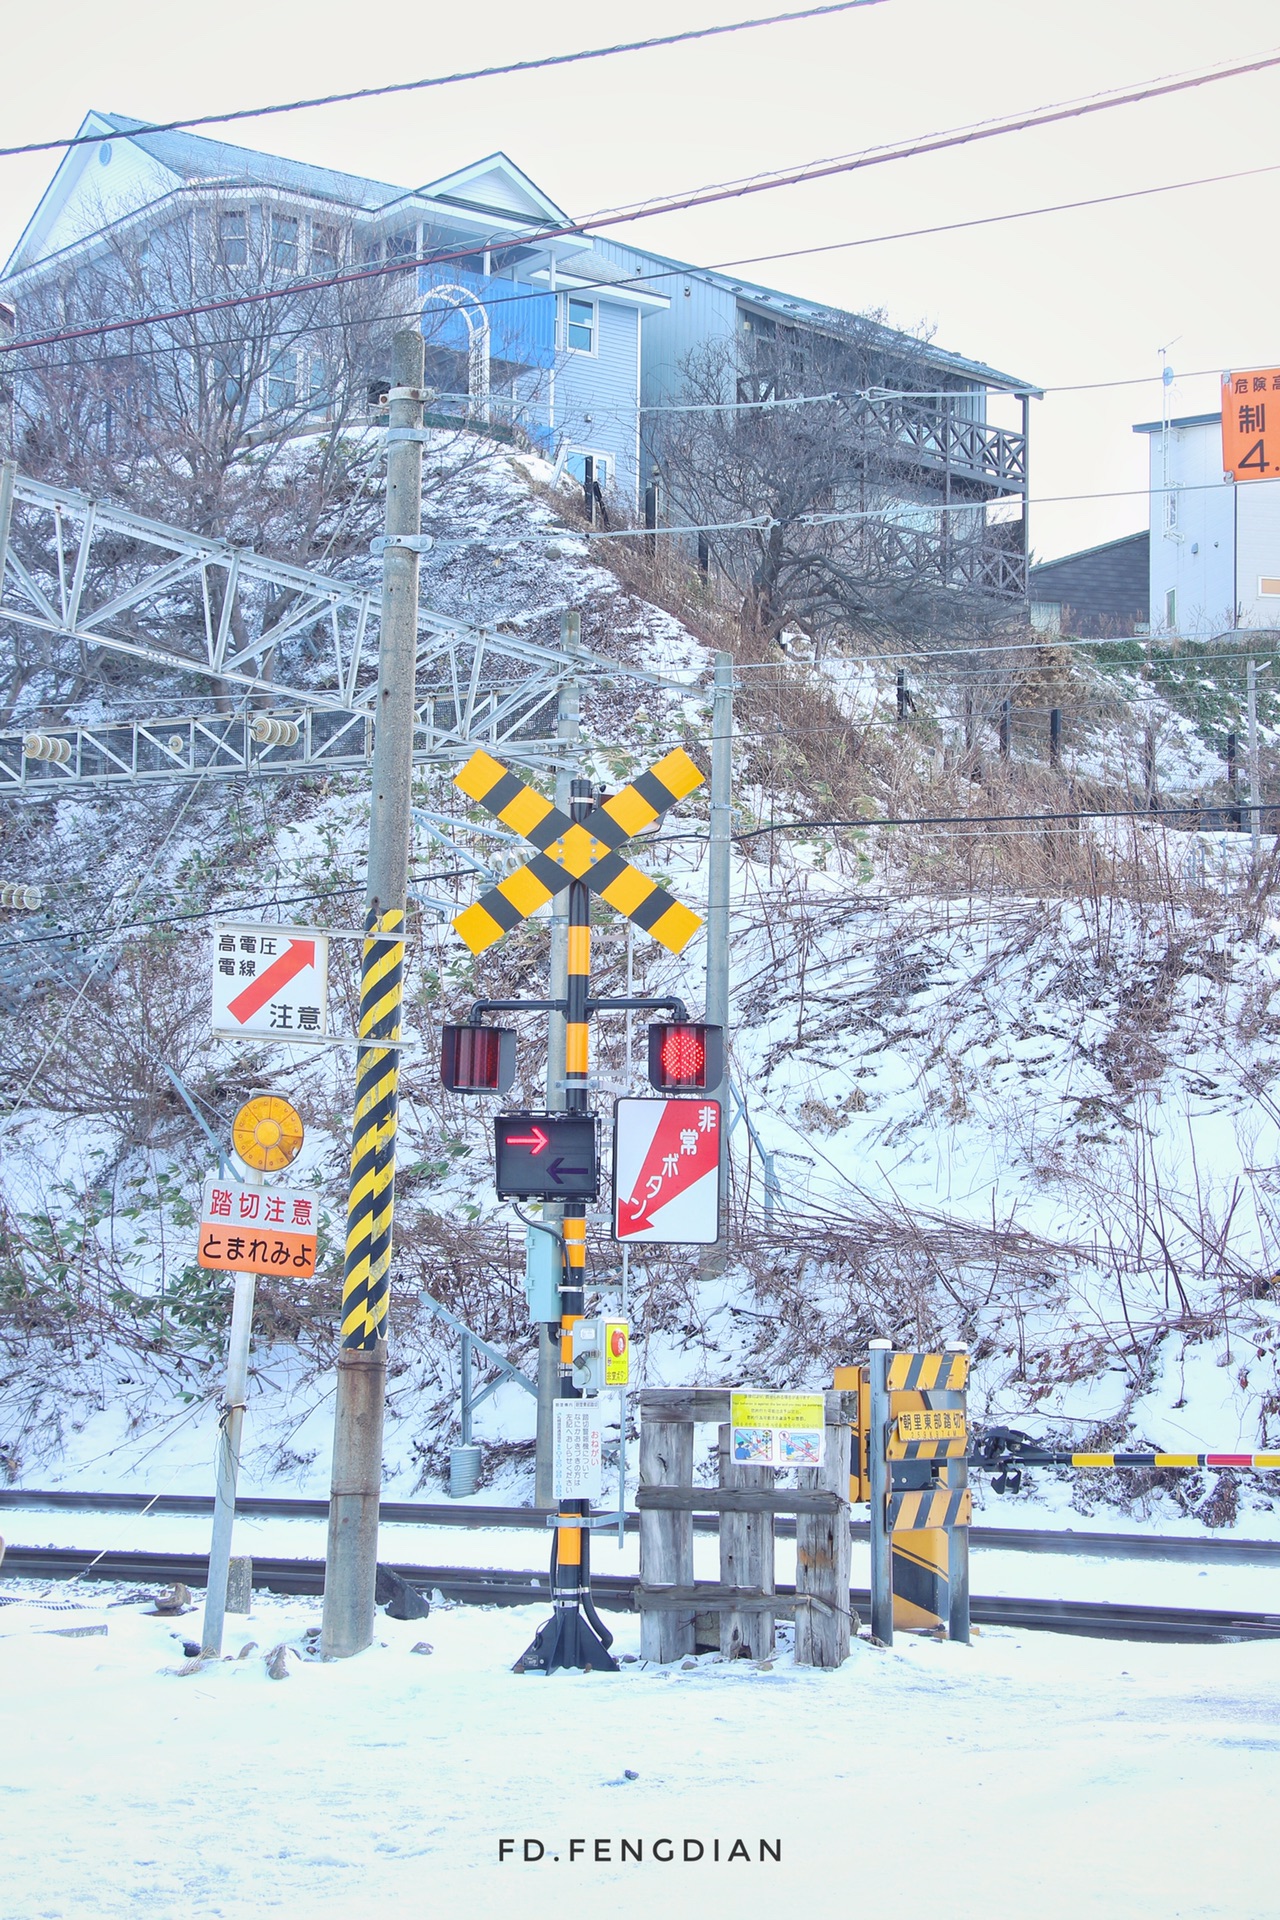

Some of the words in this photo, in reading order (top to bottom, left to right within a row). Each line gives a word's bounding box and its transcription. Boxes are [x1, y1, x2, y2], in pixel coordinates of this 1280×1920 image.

[1238, 403, 1266, 434] 制
[218, 933, 278, 956] 高電圧
[218, 957, 256, 977] 電線
[269, 1003, 321, 1031] 注意
[630, 1105, 717, 1221] 非常ボタン
[209, 1188, 313, 1226] 踏切注意
[202, 1233, 312, 1268] とまれみよ
[590, 1430, 600, 1466] おねがい
